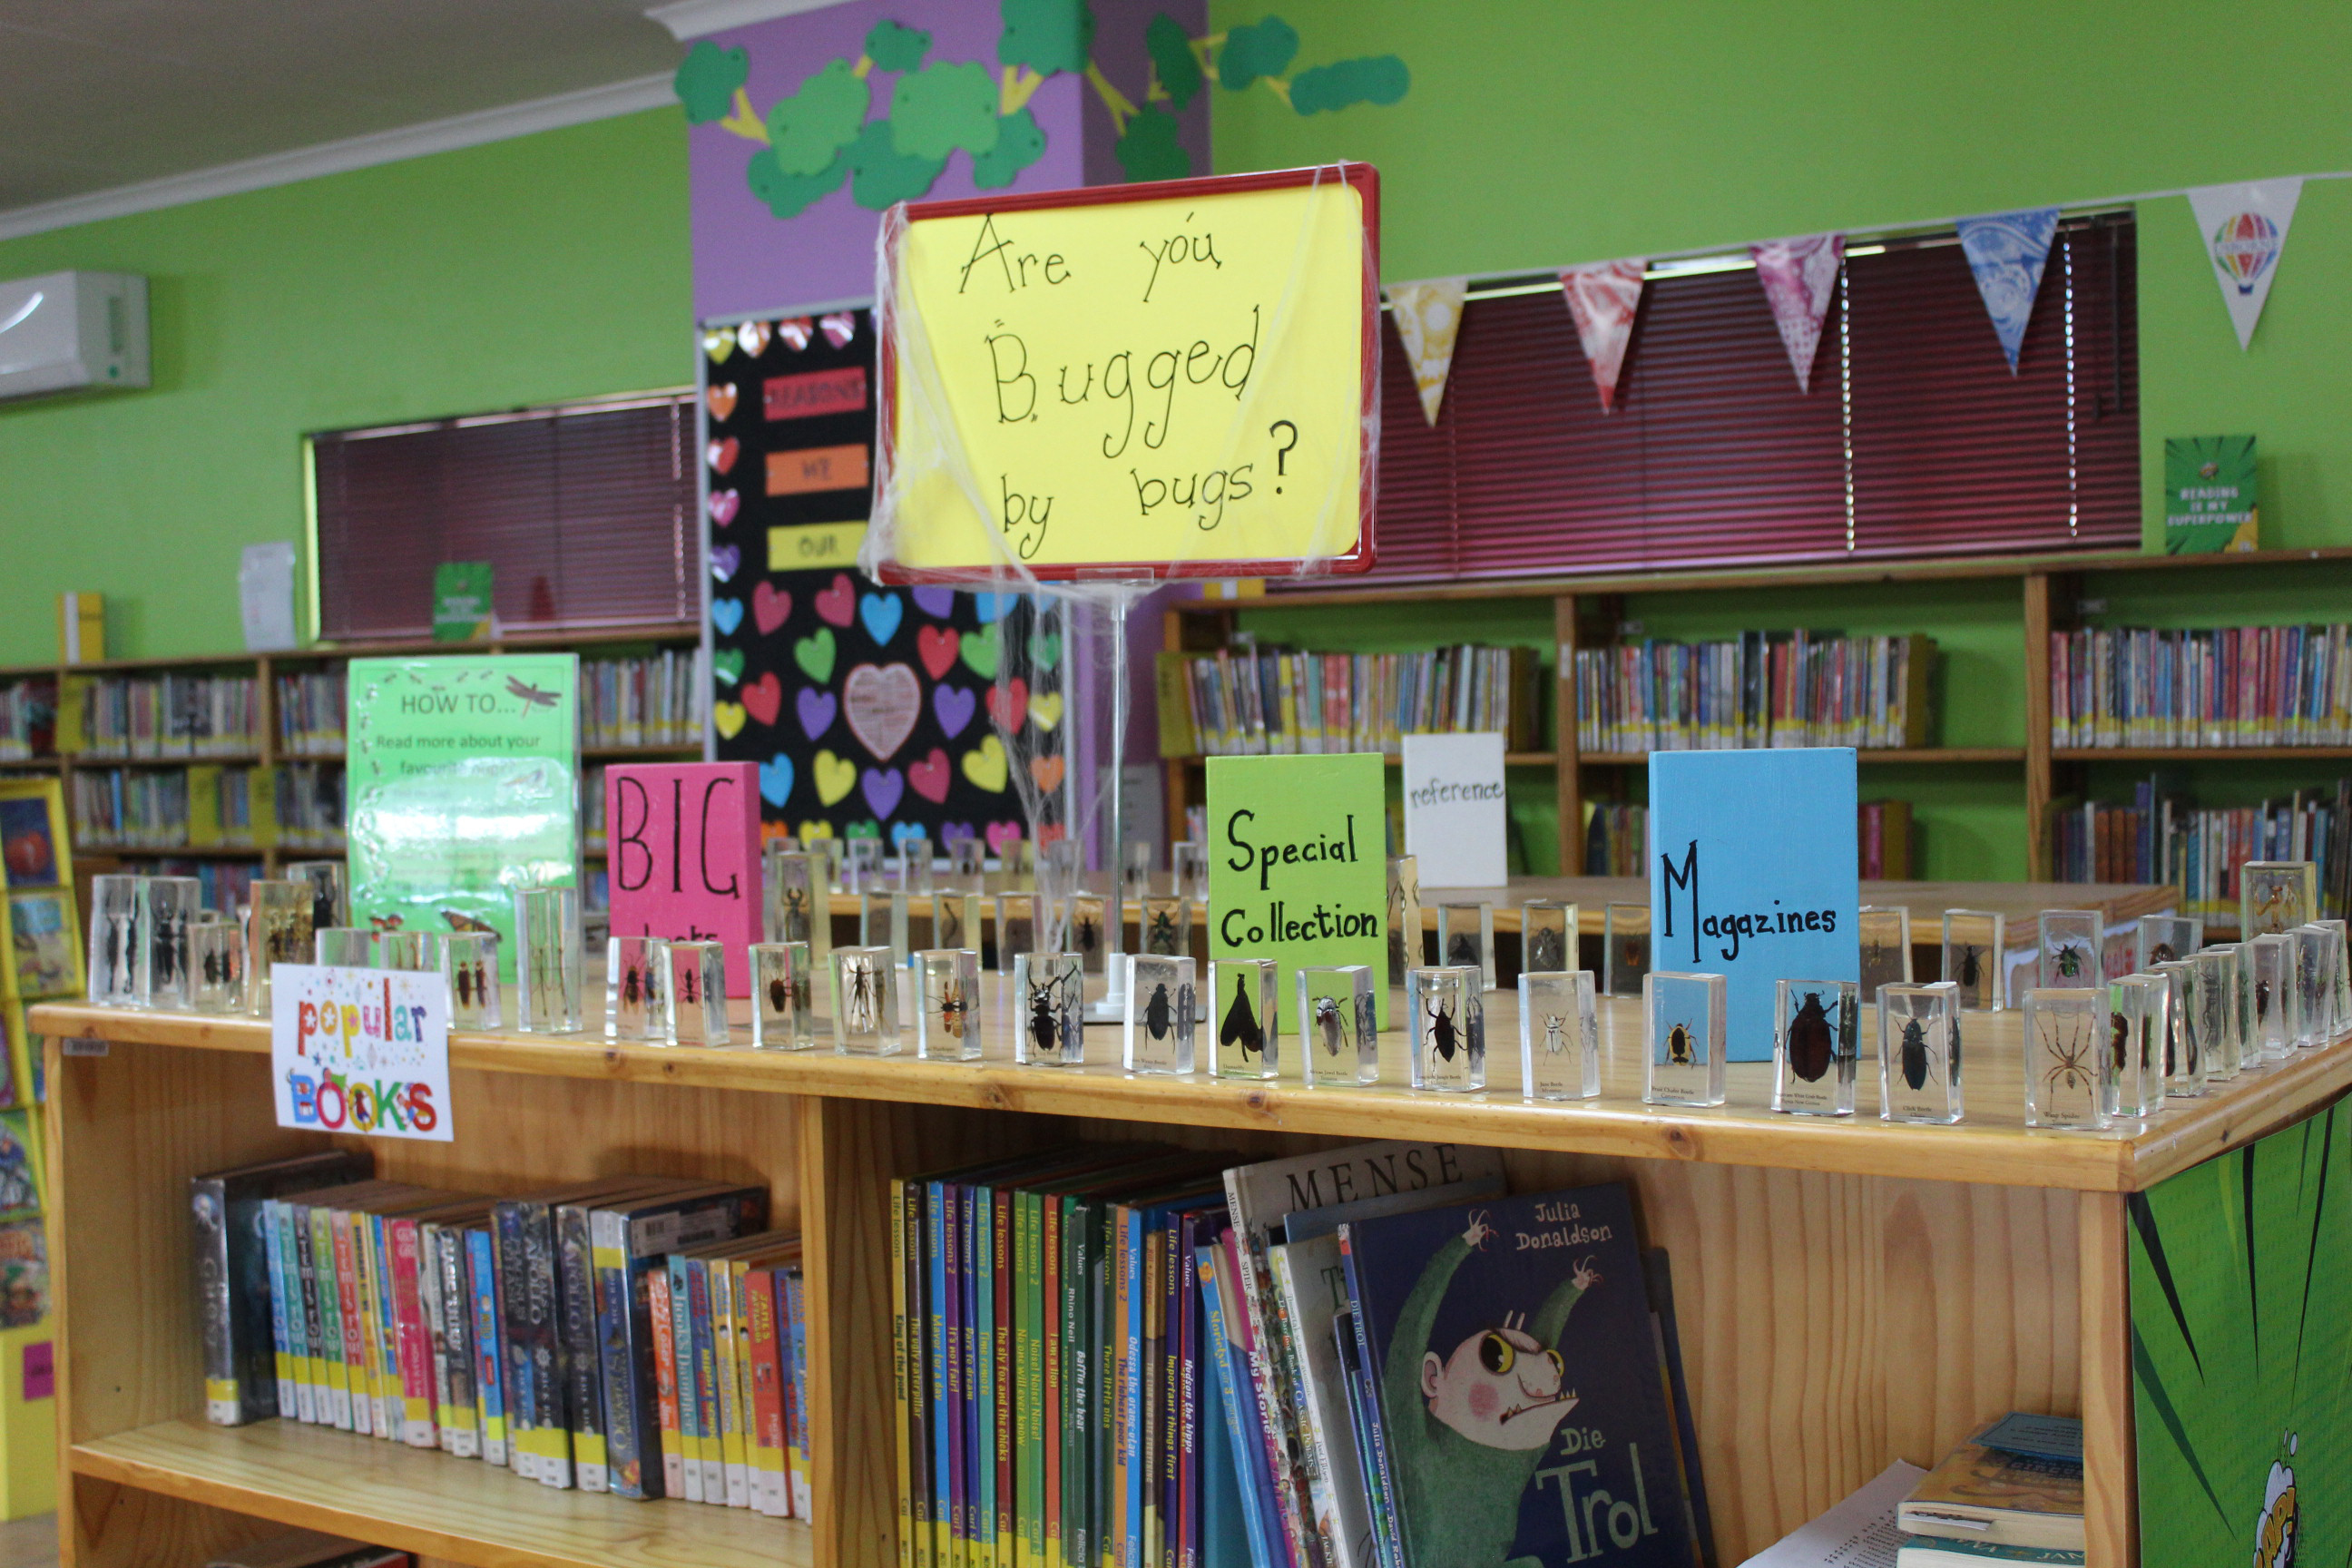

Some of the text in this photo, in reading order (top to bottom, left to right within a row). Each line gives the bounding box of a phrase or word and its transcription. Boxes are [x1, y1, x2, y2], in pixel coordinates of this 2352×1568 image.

[960, 213, 1222, 302] Are you
[985, 305, 1259, 459] Bugged
[1002, 420, 1298, 559] by bugs?
[2180, 486, 2239, 501] READING
[2207, 500, 2230, 512] MY
[2167, 512, 2253, 526] SUPERPOWER
[401, 694, 458, 714] HOW
[377, 735, 541, 751] Read more about your
[1411, 777, 1505, 808] reference
[617, 776, 740, 900] BIG
[1228, 808, 1358, 890] Special
[1661, 839, 1837, 963] Magazines
[1221, 901, 1378, 946] Collection
[297, 977, 427, 1058] popular
[289, 1073, 438, 1133] BOOKS
[1287, 1143, 1464, 1213] MENSE
[893, 1196, 904, 1259] Life lessons
[907, 1198, 918, 1260] Life lessons
[930, 1194, 941, 1259] Life lessons
[946, 1200, 956, 1219] Life
[964, 1200, 974, 1219] Life
[979, 1202, 989, 1222] Life
[1534, 1201, 1582, 1222] Julia
[946, 1222, 957, 1263] lessons
[964, 1222, 974, 1264] lessons
[979, 1226, 990, 1267] lessons
[997, 1205, 1008, 1269] Life lessons
[1016, 1208, 1027, 1272] Life lessons
[1030, 1210, 1041, 1286] Life lessons 2
[1049, 1210, 1059, 1276] Life lessons
[1119, 1225, 1129, 1245] Life
[1227, 1191, 1252, 1290] MENSE SPIER
[1515, 1223, 1613, 1250] Donaldson
[1077, 1244, 1086, 1276] Values
[1119, 1249, 1128, 1290] lessons
[1128, 1249, 1138, 1280] Values
[1168, 1229, 1178, 1297] Life lessons
[1184, 1255, 1192, 1288] Values
[1278, 1298, 1288, 1316] The
[1288, 1353, 1298, 1377] Book
[1350, 1299, 1366, 1349] DIE TROL
[948, 1327, 961, 1393] It's not fair!
[966, 1354, 975, 1365] to
[1031, 1338, 1042, 1371] Noise!
[1050, 1340, 1059, 1357] am
[1128, 1336, 1139, 1372] Odessa
[1249, 1350, 1260, 1377] My
[966, 1367, 978, 1400] dream
[996, 1326, 1011, 1462] The sly fox and the chicks
[1017, 1328, 1029, 1446] No one will ever know
[1049, 1367, 1060, 1388] lion
[1076, 1350, 1087, 1433] Baffin the bear
[1103, 1345, 1114, 1403] Three little
[1128, 1376, 1139, 1393] the
[1032, 1407, 1043, 1441] Noise!
[1116, 1357, 1129, 1466] The richest poor kid
[1165, 1355, 1178, 1481] Important things first
[1183, 1358, 1194, 1454] Hudson the hippo
[1560, 1426, 1606, 1455] Die
[1372, 1421, 1398, 1541] Julia Donaldson David
[1534, 1441, 1659, 1564] Trol
[1077, 1528, 1087, 1563] Felicia
[1116, 1543, 1126, 1566] Carl
